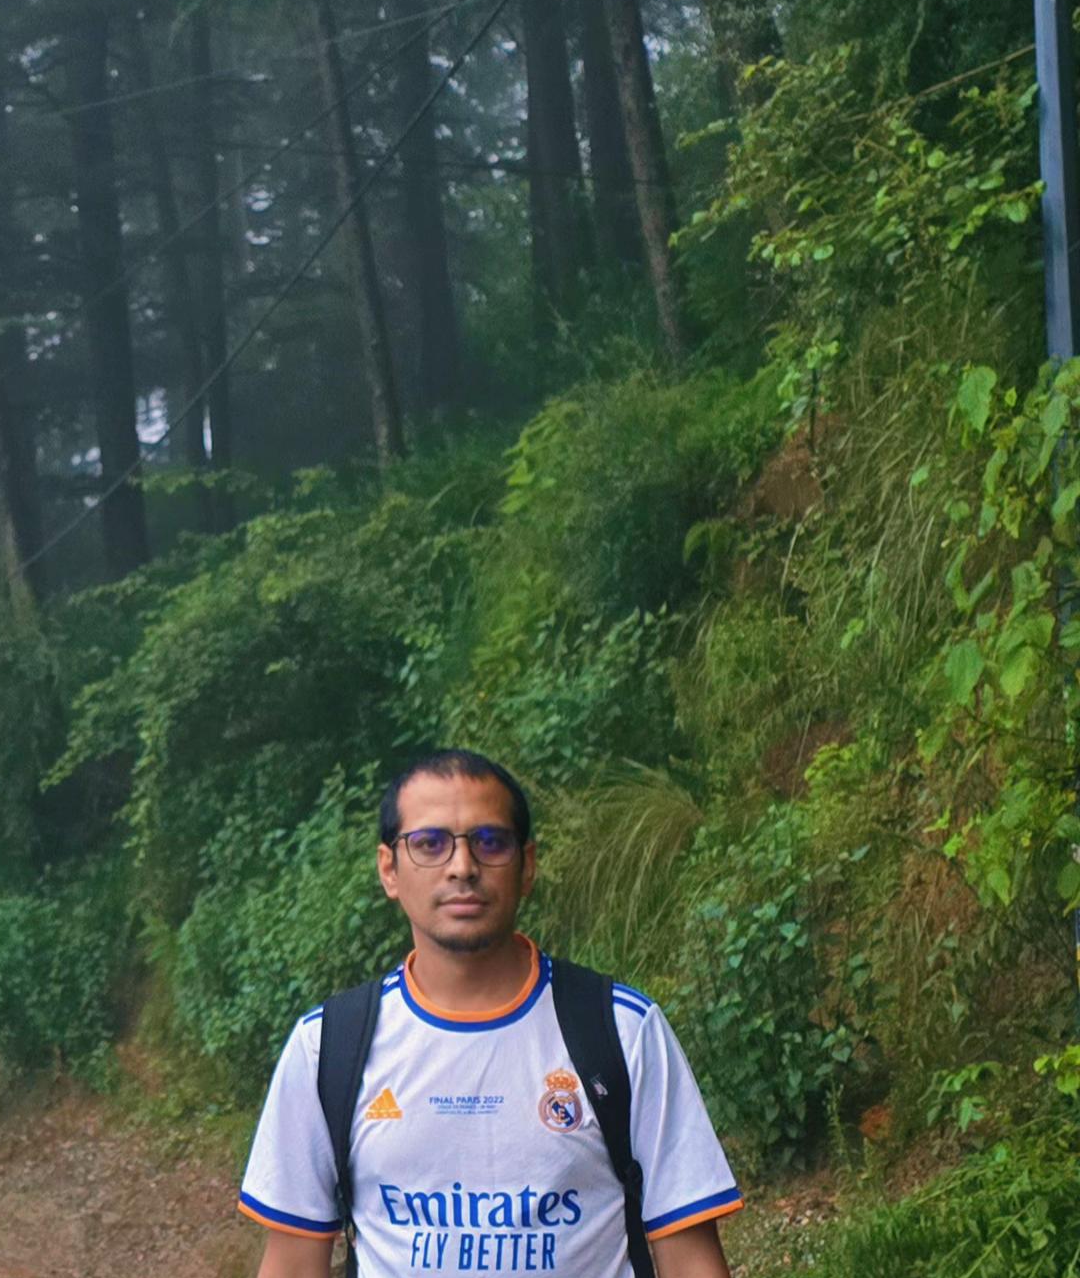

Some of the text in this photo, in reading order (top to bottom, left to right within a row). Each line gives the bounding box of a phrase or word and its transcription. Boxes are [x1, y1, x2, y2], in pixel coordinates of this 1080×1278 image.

[429, 1095, 505, 1105] FINAL PARIS 2022
[378, 1181, 582, 1228] Emirates
[411, 1232, 556, 1270] FLY BETTER
